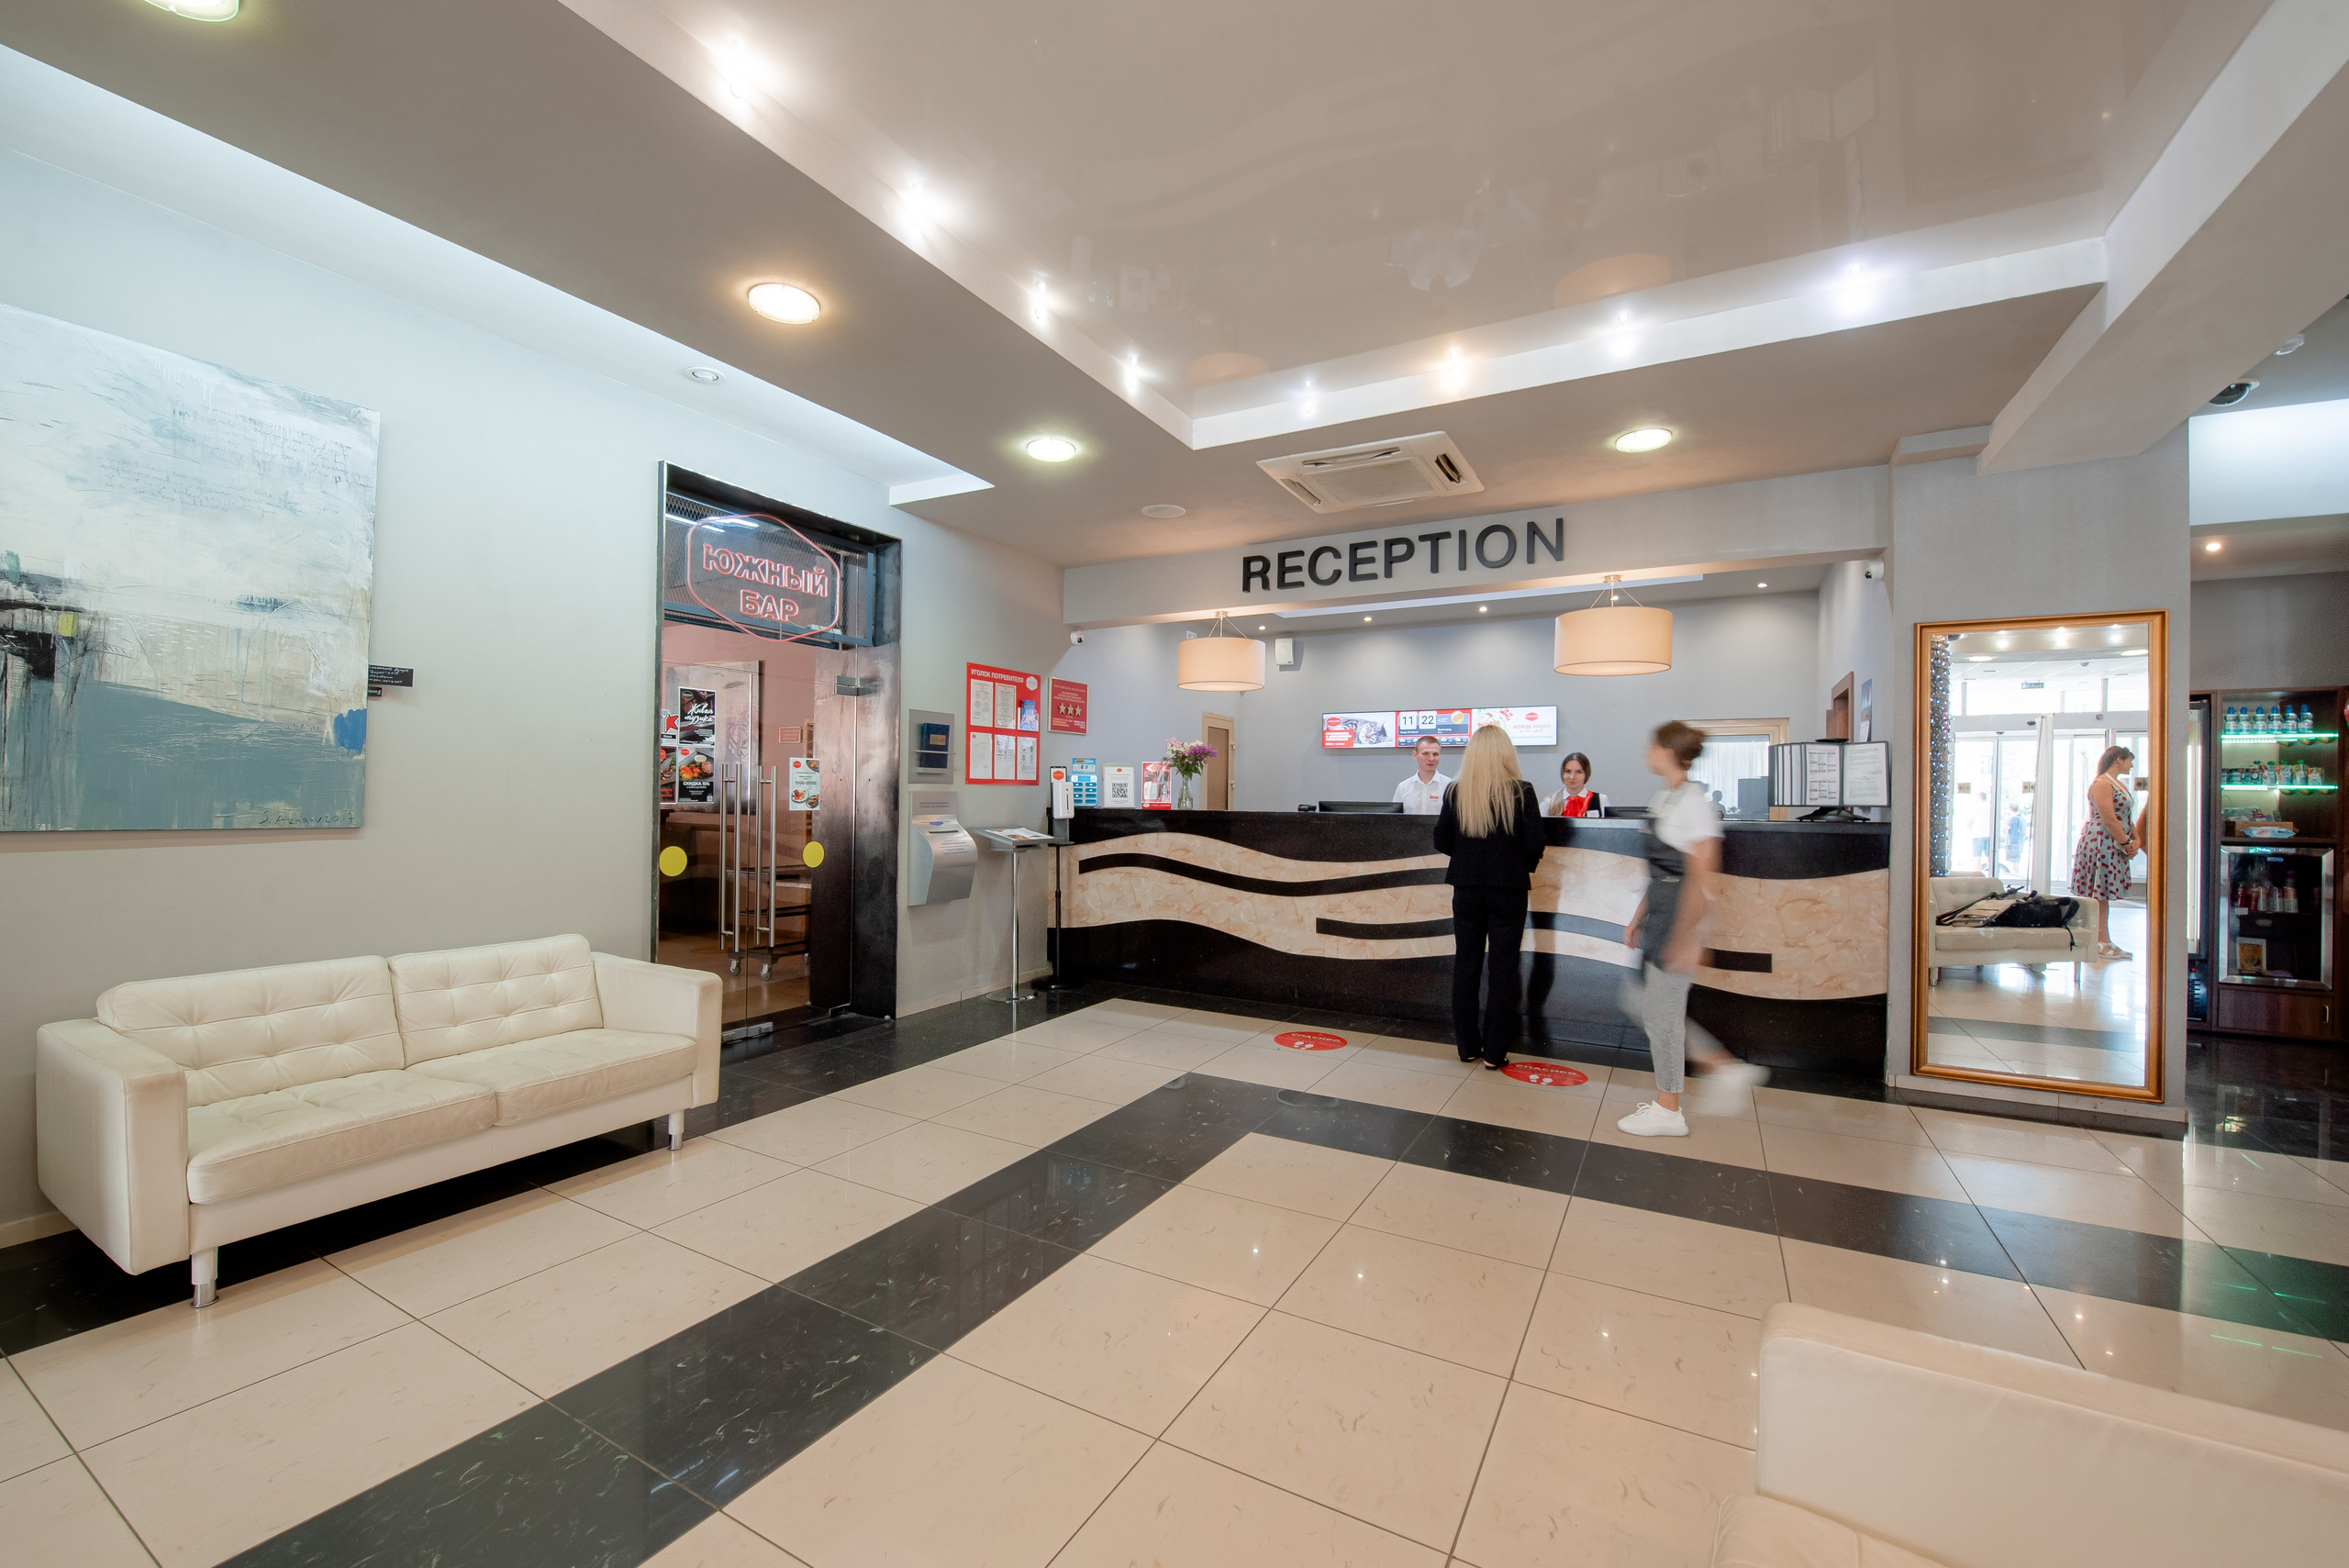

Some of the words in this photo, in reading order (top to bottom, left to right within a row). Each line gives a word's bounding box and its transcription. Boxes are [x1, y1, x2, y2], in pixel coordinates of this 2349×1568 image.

[703, 543, 829, 597] ЮЖНЫЙ
[1241, 517, 1564, 593] RECEPTION
[740, 589, 799, 623] БАР
[971, 669, 990, 678] УГОЛОК
[991, 673, 1024, 684] ПОТРЕБИТЕЛЯ
[1402, 716, 1413, 725] 11
[1421, 715, 1434, 725] 22
